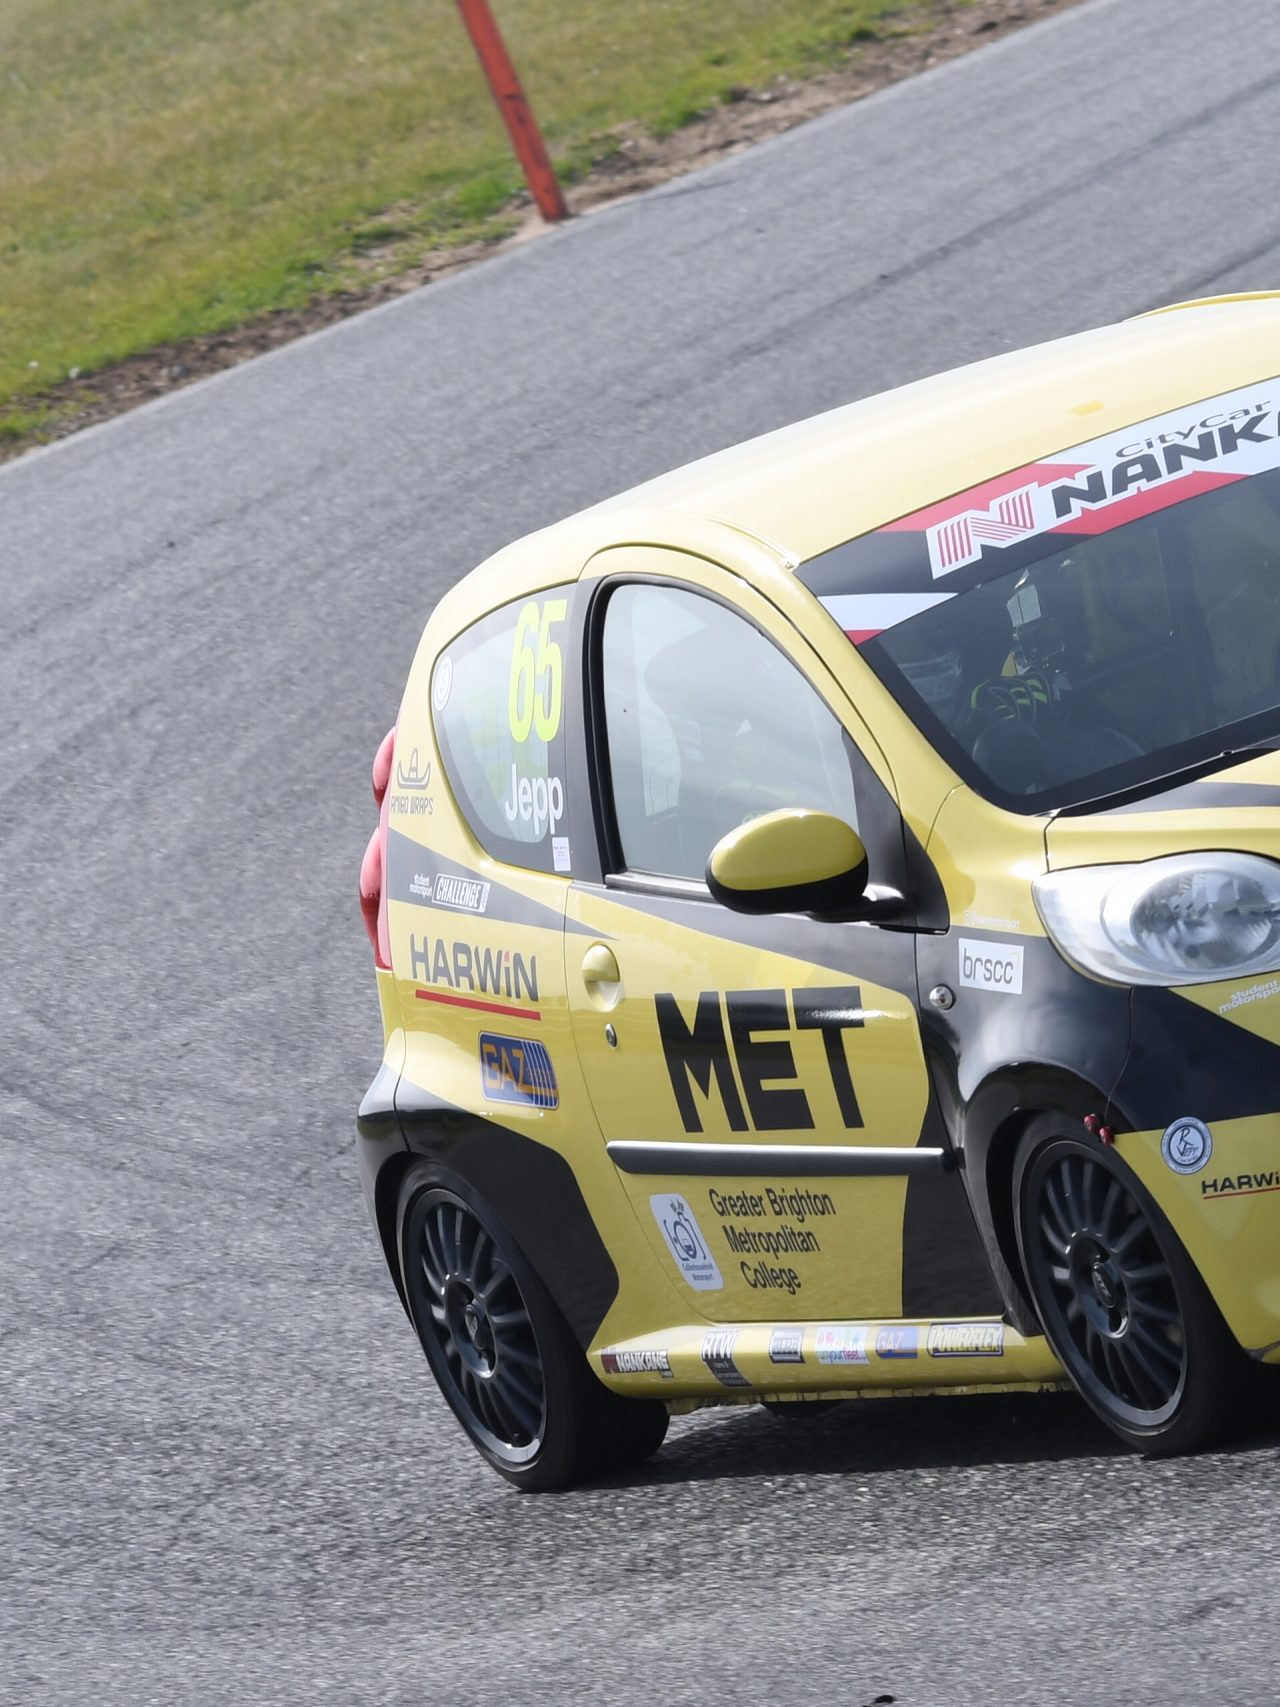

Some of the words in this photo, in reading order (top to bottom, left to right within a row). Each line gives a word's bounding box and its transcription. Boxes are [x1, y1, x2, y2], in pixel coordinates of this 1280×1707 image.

[1115, 401, 1271, 459] CityCar
[508, 599, 567, 743] 65
[410, 797, 434, 816] WRAPS
[504, 763, 564, 835] Jepp
[437, 875, 482, 910] CHALLENGE
[963, 947, 1014, 985] brscc
[1231, 979, 1278, 1001] student
[483, 1043, 559, 1099] GAZ
[654, 985, 866, 1134] MET
[708, 1188, 768, 1217] Greater
[765, 1187, 837, 1223] Brighton
[722, 1224, 821, 1260] Metropolitan
[740, 1260, 802, 1295] College
